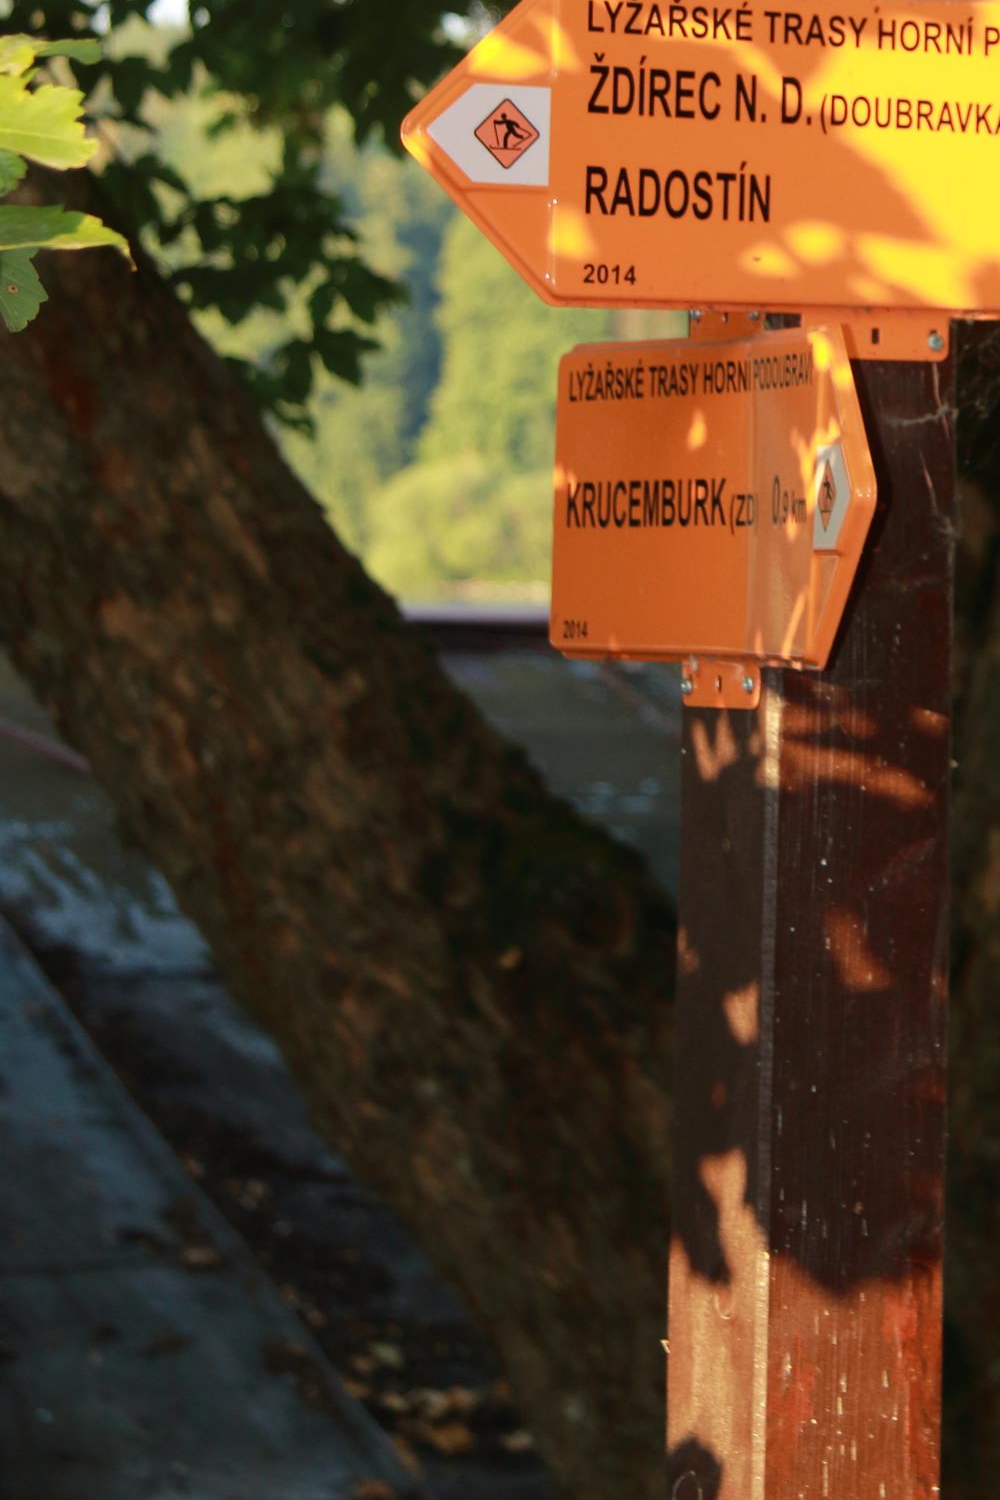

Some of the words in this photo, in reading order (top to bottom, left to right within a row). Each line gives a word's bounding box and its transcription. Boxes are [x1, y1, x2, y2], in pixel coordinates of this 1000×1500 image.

[763, 11, 869, 49] TRASY
[877, 17, 974, 56] HORNÍ
[587, 54, 722, 117] ŽDÍREC
[734, 74, 767, 123] N.
[584, 161, 771, 223] RADOSTÍN
[583, 263, 637, 287] 2014
[568, 359, 645, 403] LYŽAŘSKÉ
[649, 363, 700, 398] TRASY
[566, 478, 728, 529] KRUCEMBURK
[563, 619, 589, 640] 2014
